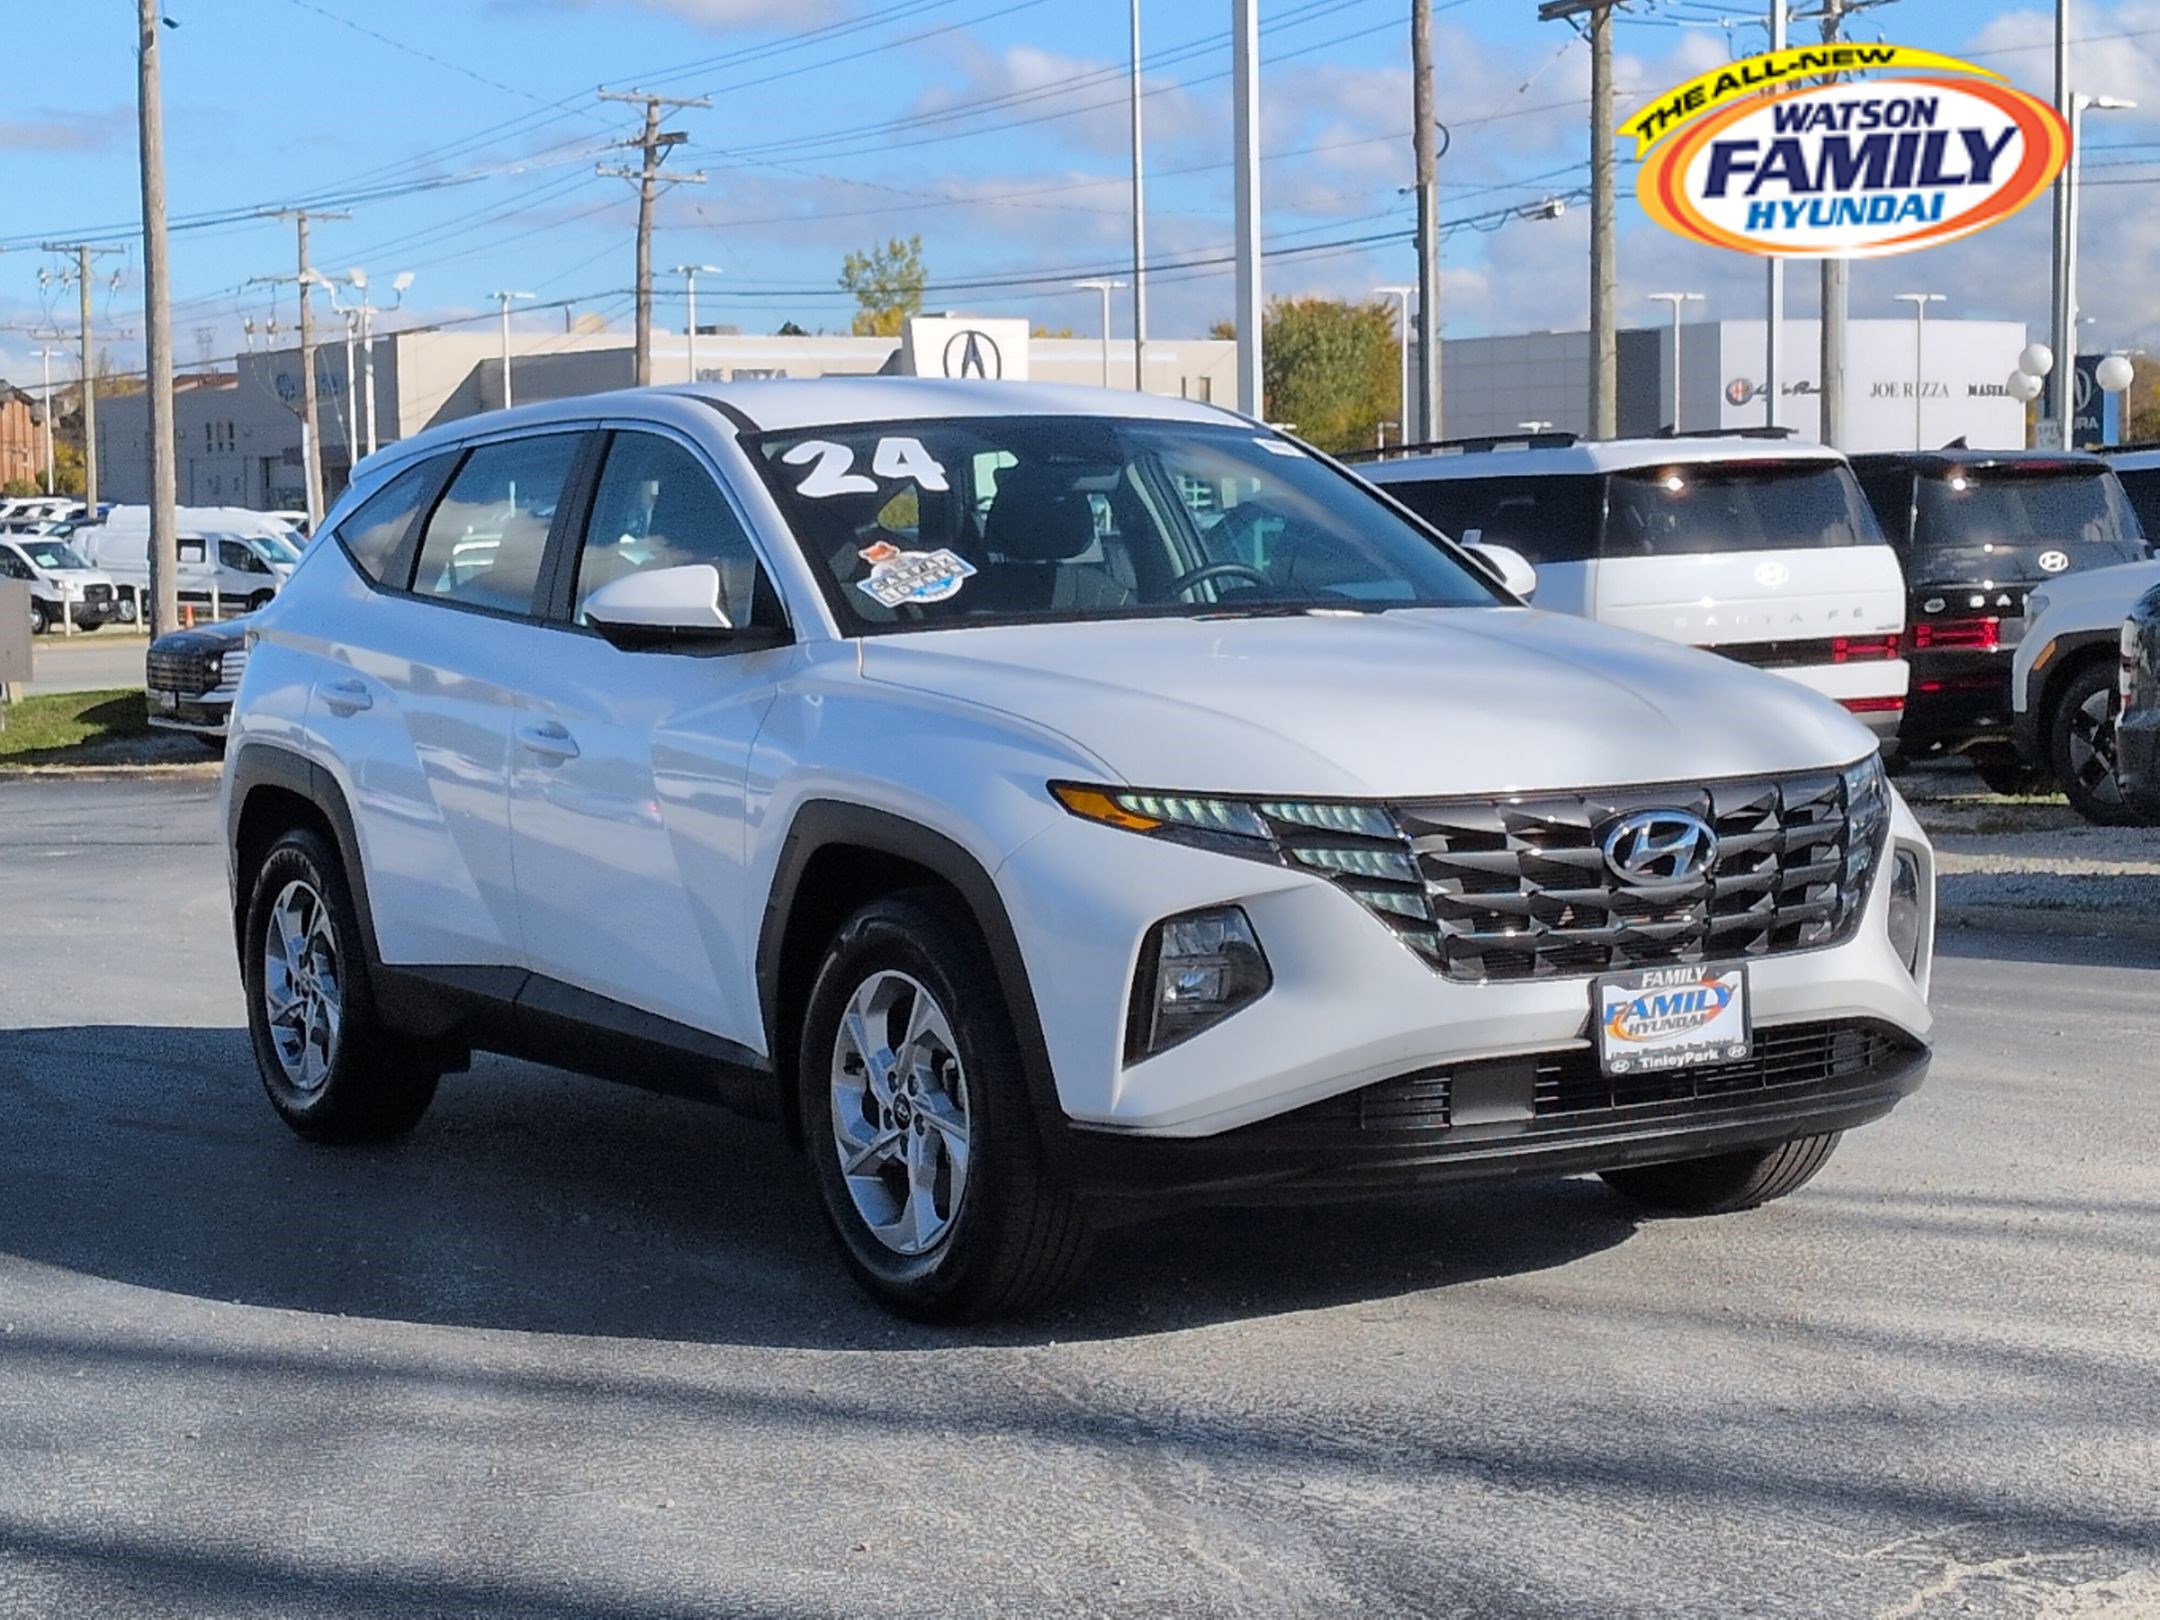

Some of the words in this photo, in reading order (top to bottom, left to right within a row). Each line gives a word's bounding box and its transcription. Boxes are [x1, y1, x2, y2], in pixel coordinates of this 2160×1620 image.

[1870, 382, 1898, 398] JOE
[782, 437, 949, 498] 24
[1828, 606, 1863, 621] FE
[1642, 967, 1707, 988] FAMILY
[1604, 984, 1737, 1024] FAMILY
[1628, 1013, 1703, 1036] HYUNDAI
[1639, 1055, 1684, 1069] Tinley
[1684, 1048, 1720, 1063] Park
